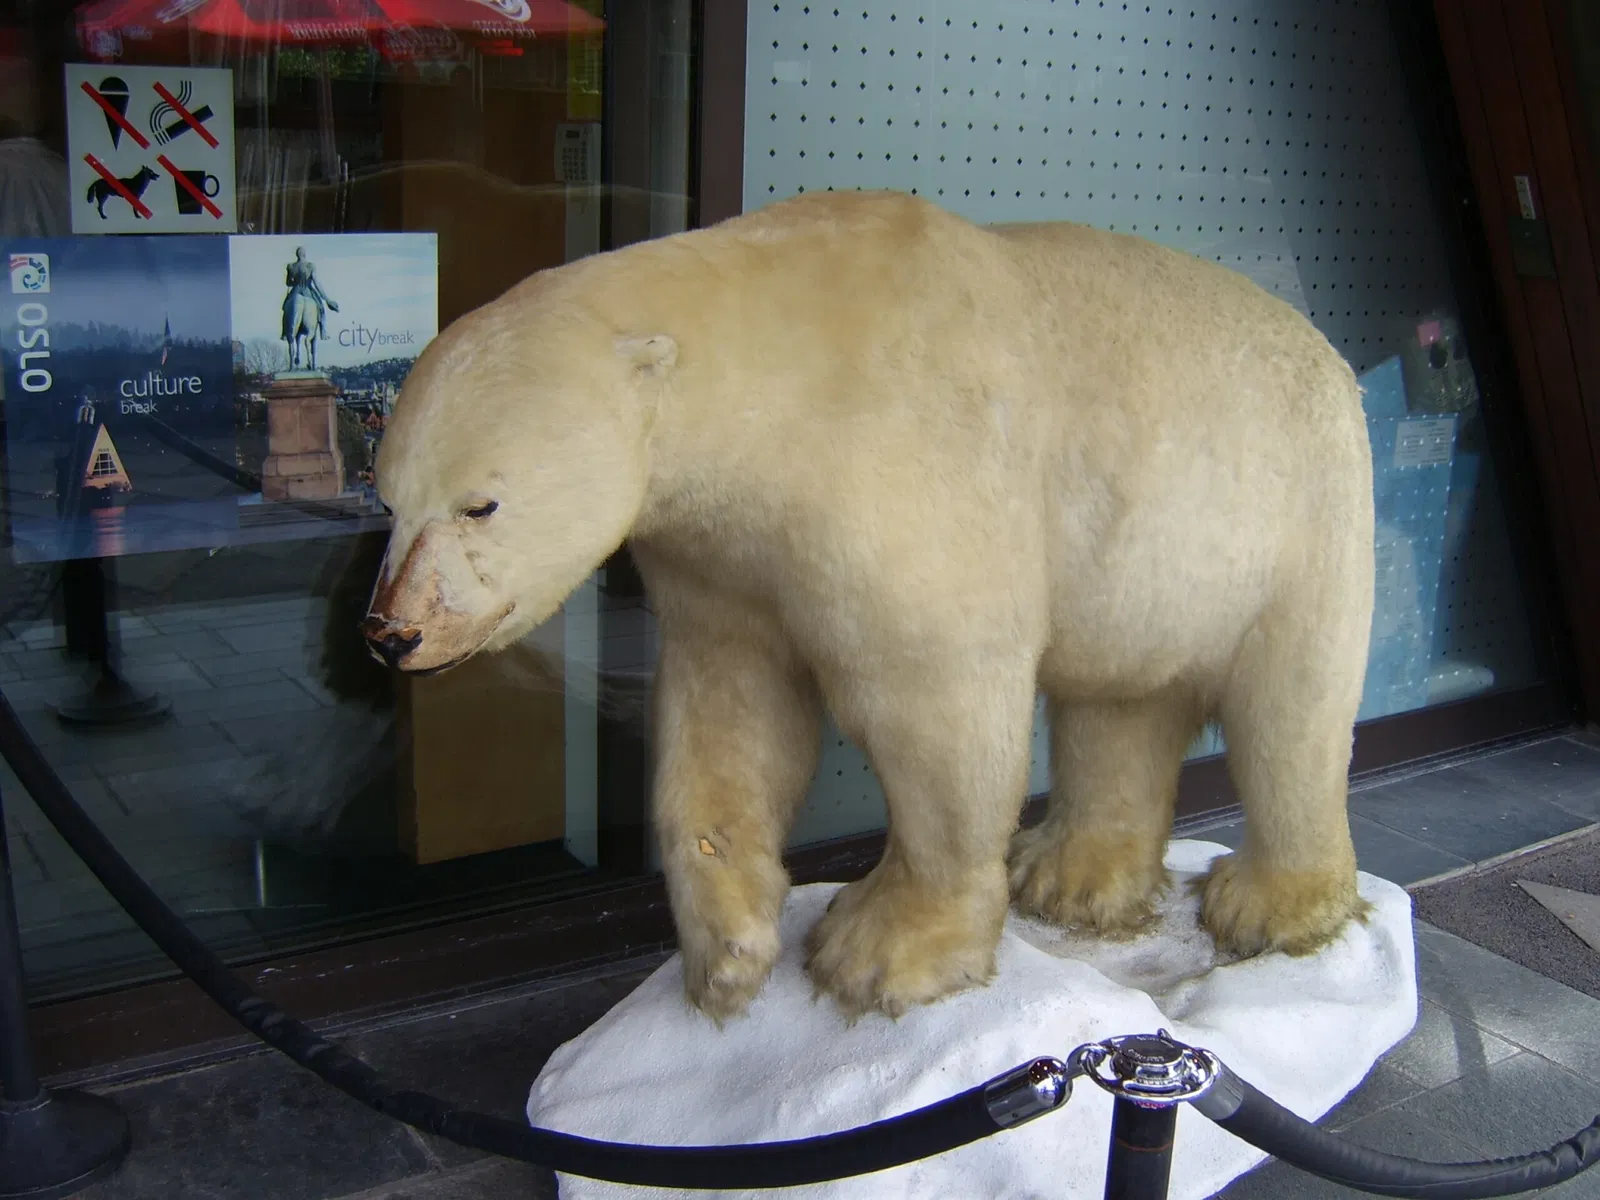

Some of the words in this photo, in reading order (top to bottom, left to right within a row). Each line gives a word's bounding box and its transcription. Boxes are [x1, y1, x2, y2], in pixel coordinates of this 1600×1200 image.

[17, 303, 52, 392] OSLO
[120, 371, 202, 398] culture
[120, 399, 158, 415] break
